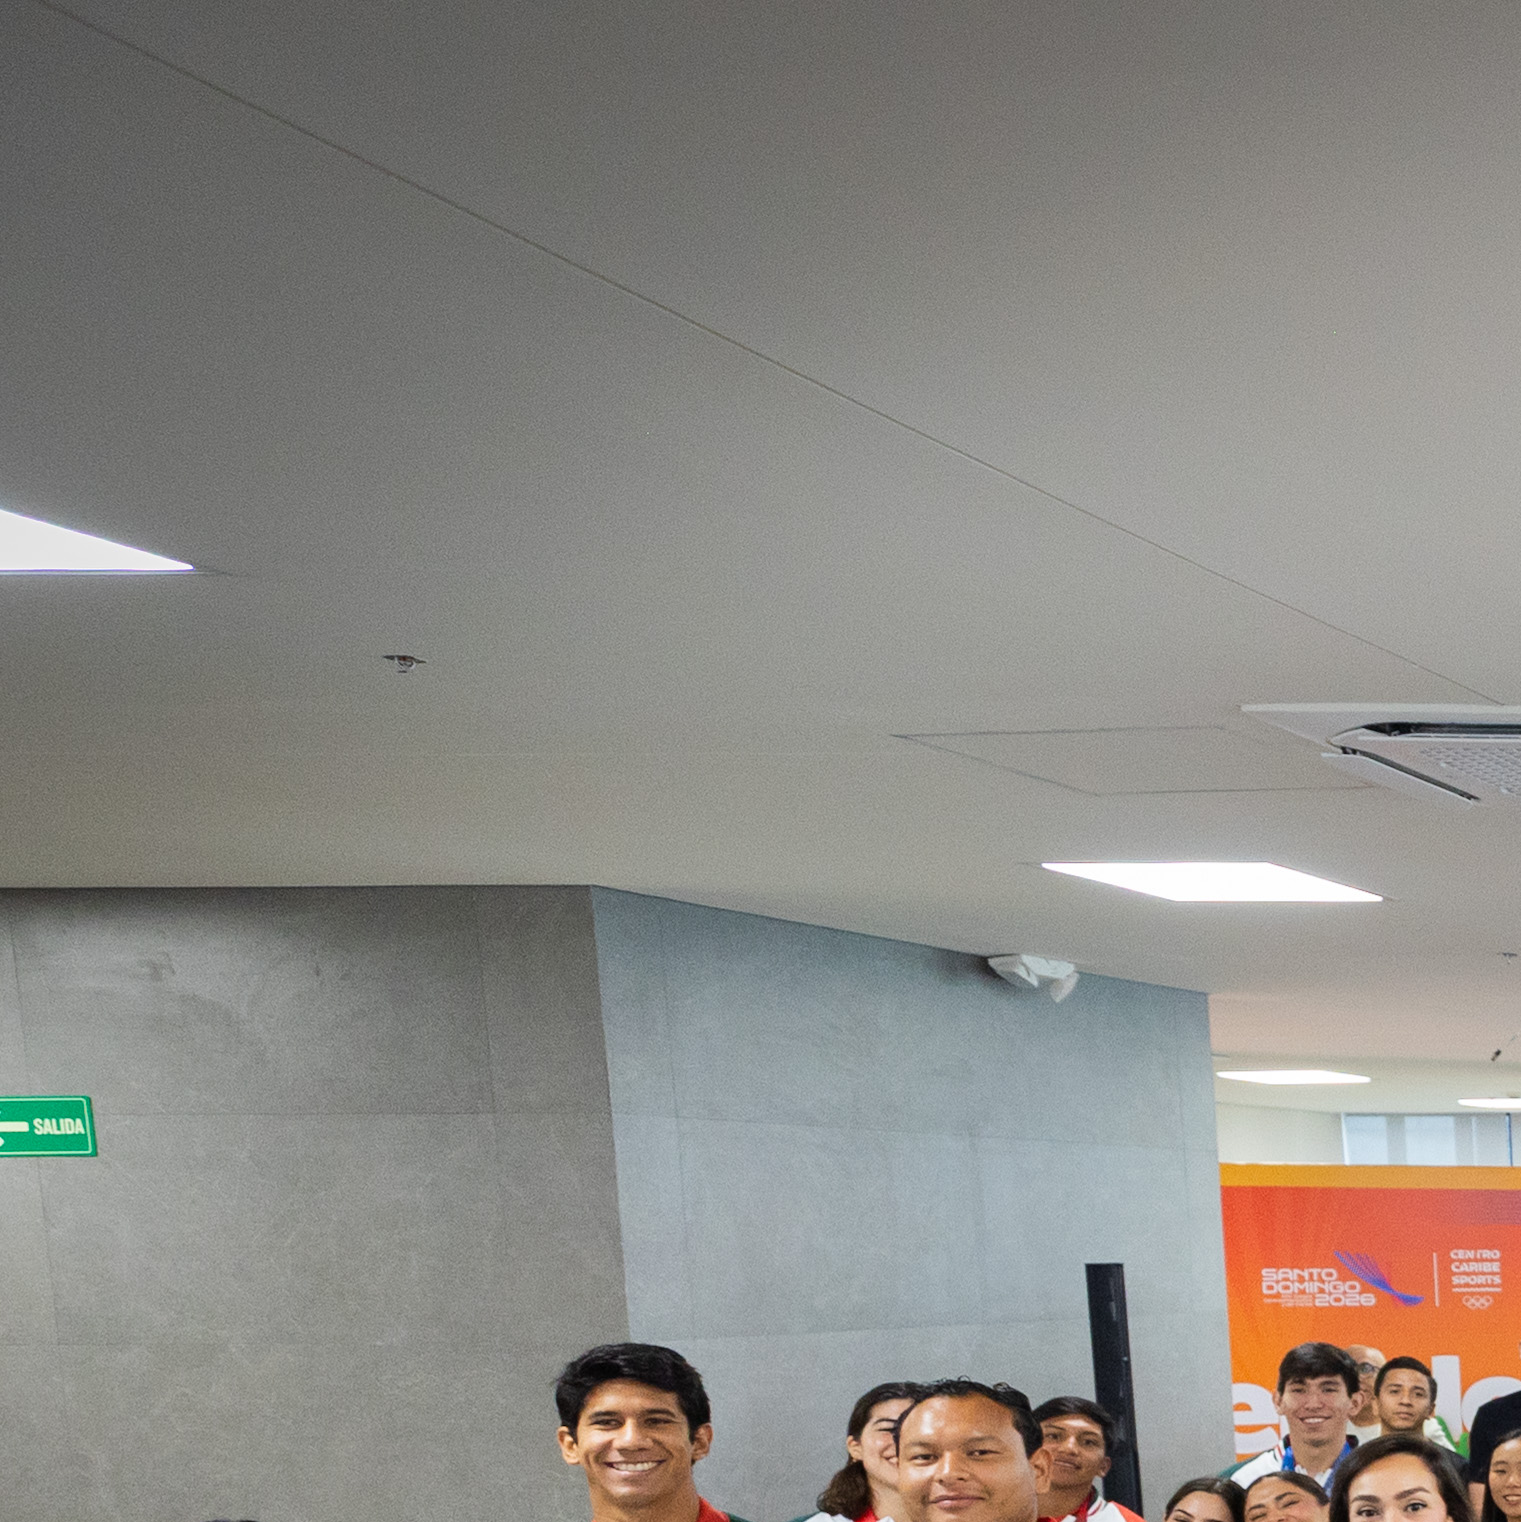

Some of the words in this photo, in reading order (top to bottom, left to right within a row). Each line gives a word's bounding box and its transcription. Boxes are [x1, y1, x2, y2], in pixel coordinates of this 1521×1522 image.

[33, 1118, 85, 1135] SALIDA
[1450, 1249, 1500, 1260] CENTRO
[1451, 1262, 1501, 1273] CARIBE
[1261, 1268, 1337, 1281] SANTO
[1452, 1275, 1501, 1285] SPORTS
[1261, 1281, 1360, 1294] DOMINGO
[1315, 1293, 1376, 1307] 2026
